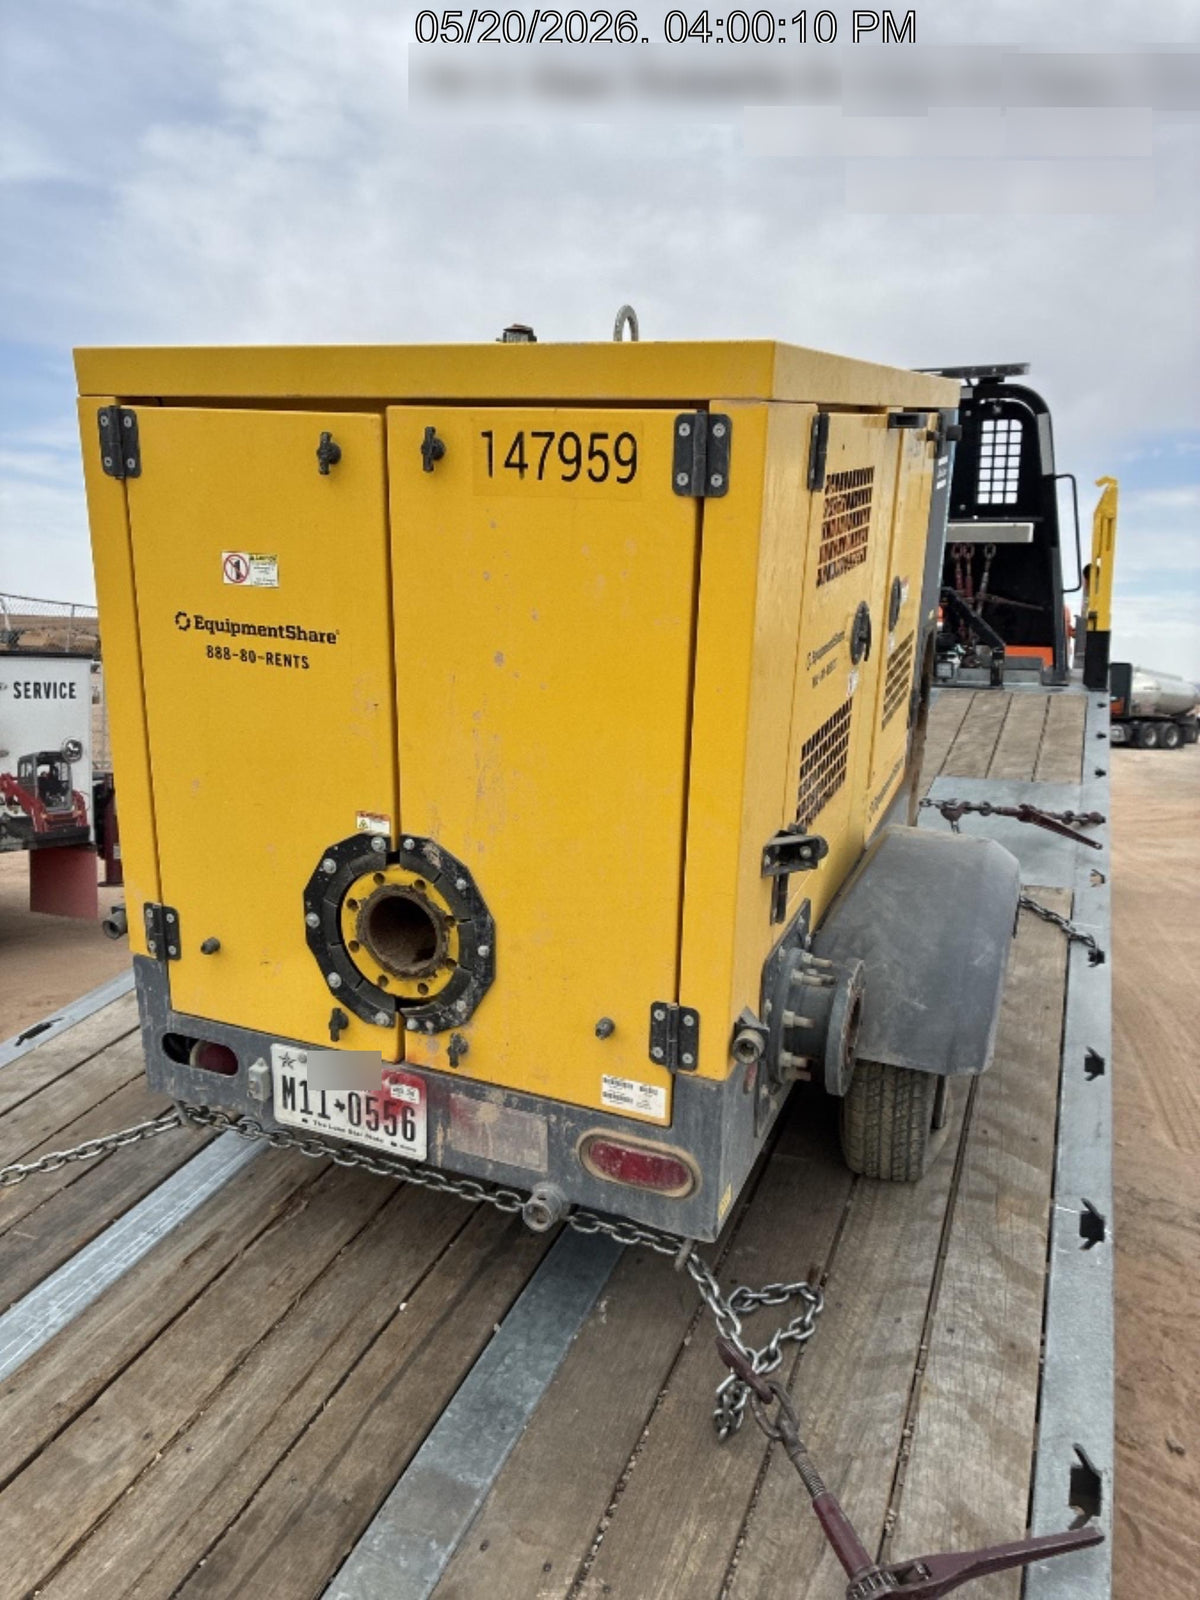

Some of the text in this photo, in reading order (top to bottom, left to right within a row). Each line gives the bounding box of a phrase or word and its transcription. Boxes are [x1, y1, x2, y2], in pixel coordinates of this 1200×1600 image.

[481, 430, 638, 484] 147959
[193, 614, 338, 644] EquipmentShare
[206, 645, 310, 670] 888-80-RENTS
[13, 681, 77, 700] SERVICE
